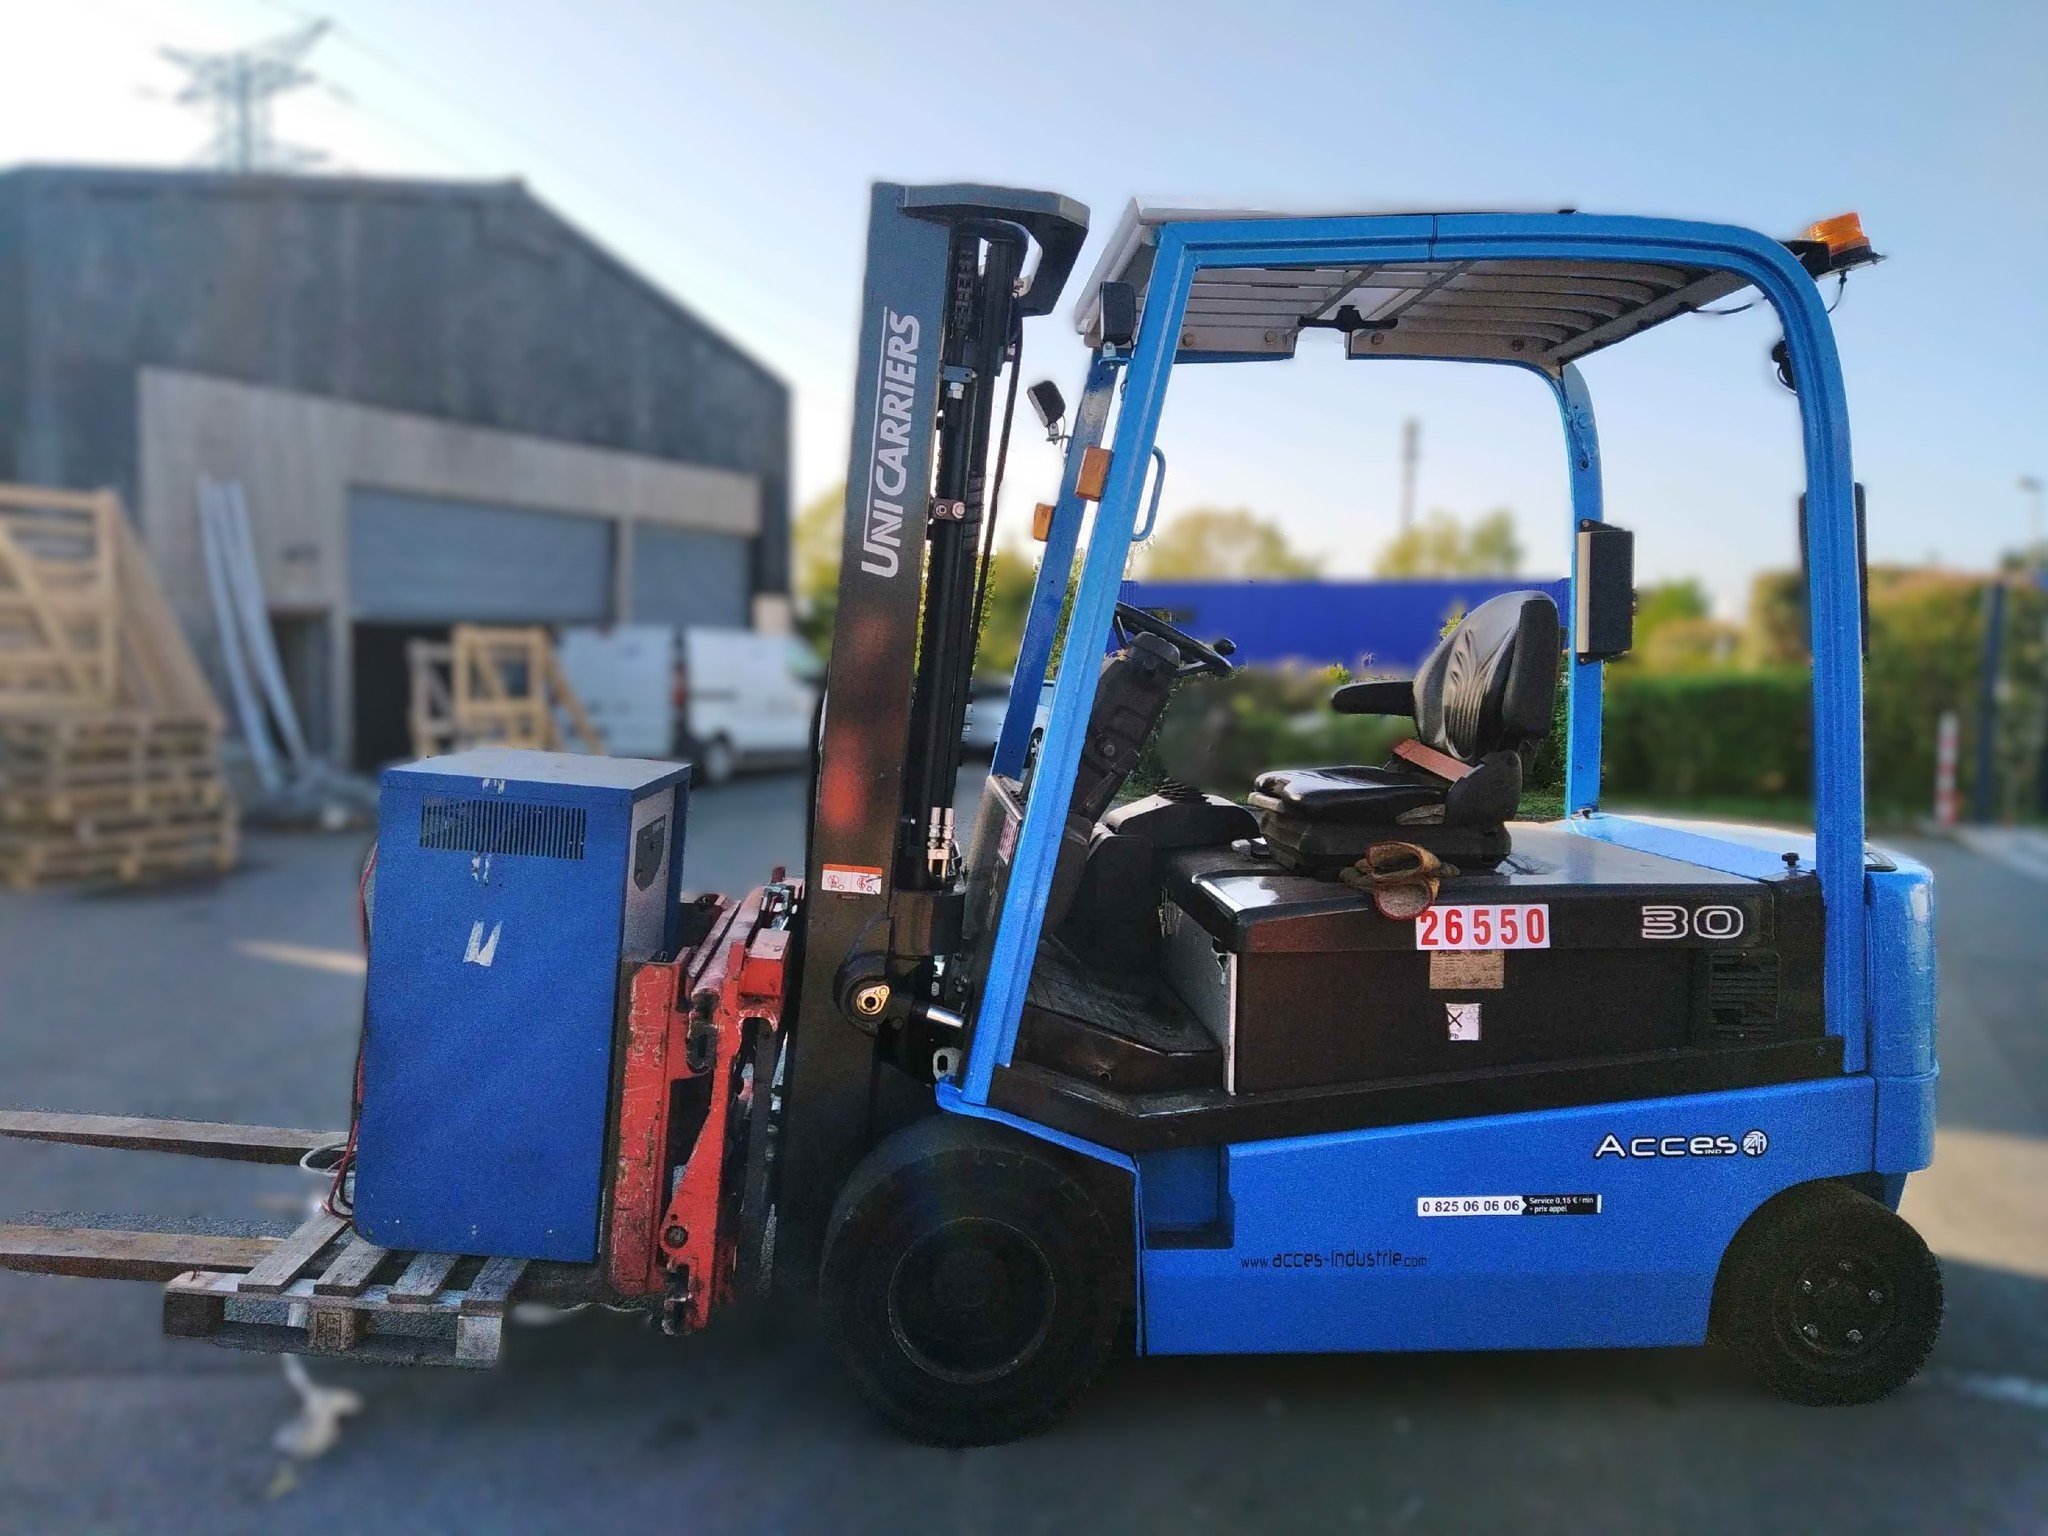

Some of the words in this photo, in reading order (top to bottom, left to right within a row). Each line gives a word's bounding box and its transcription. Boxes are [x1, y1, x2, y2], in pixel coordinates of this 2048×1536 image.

[861, 306, 920, 578] UNICARRIERS
[1420, 908, 1545, 946] 26550
[1641, 905, 1744, 940] 30
[1595, 1134, 1738, 1158] Acces
[1422, 1201, 1430, 1212] 0
[1434, 1200, 1459, 1212] 825
[1463, 1200, 1479, 1212] 06
[1483, 1200, 1499, 1211] 06
[1503, 1199, 1519, 1211] 06
[1534, 1205, 1548, 1214] prix
